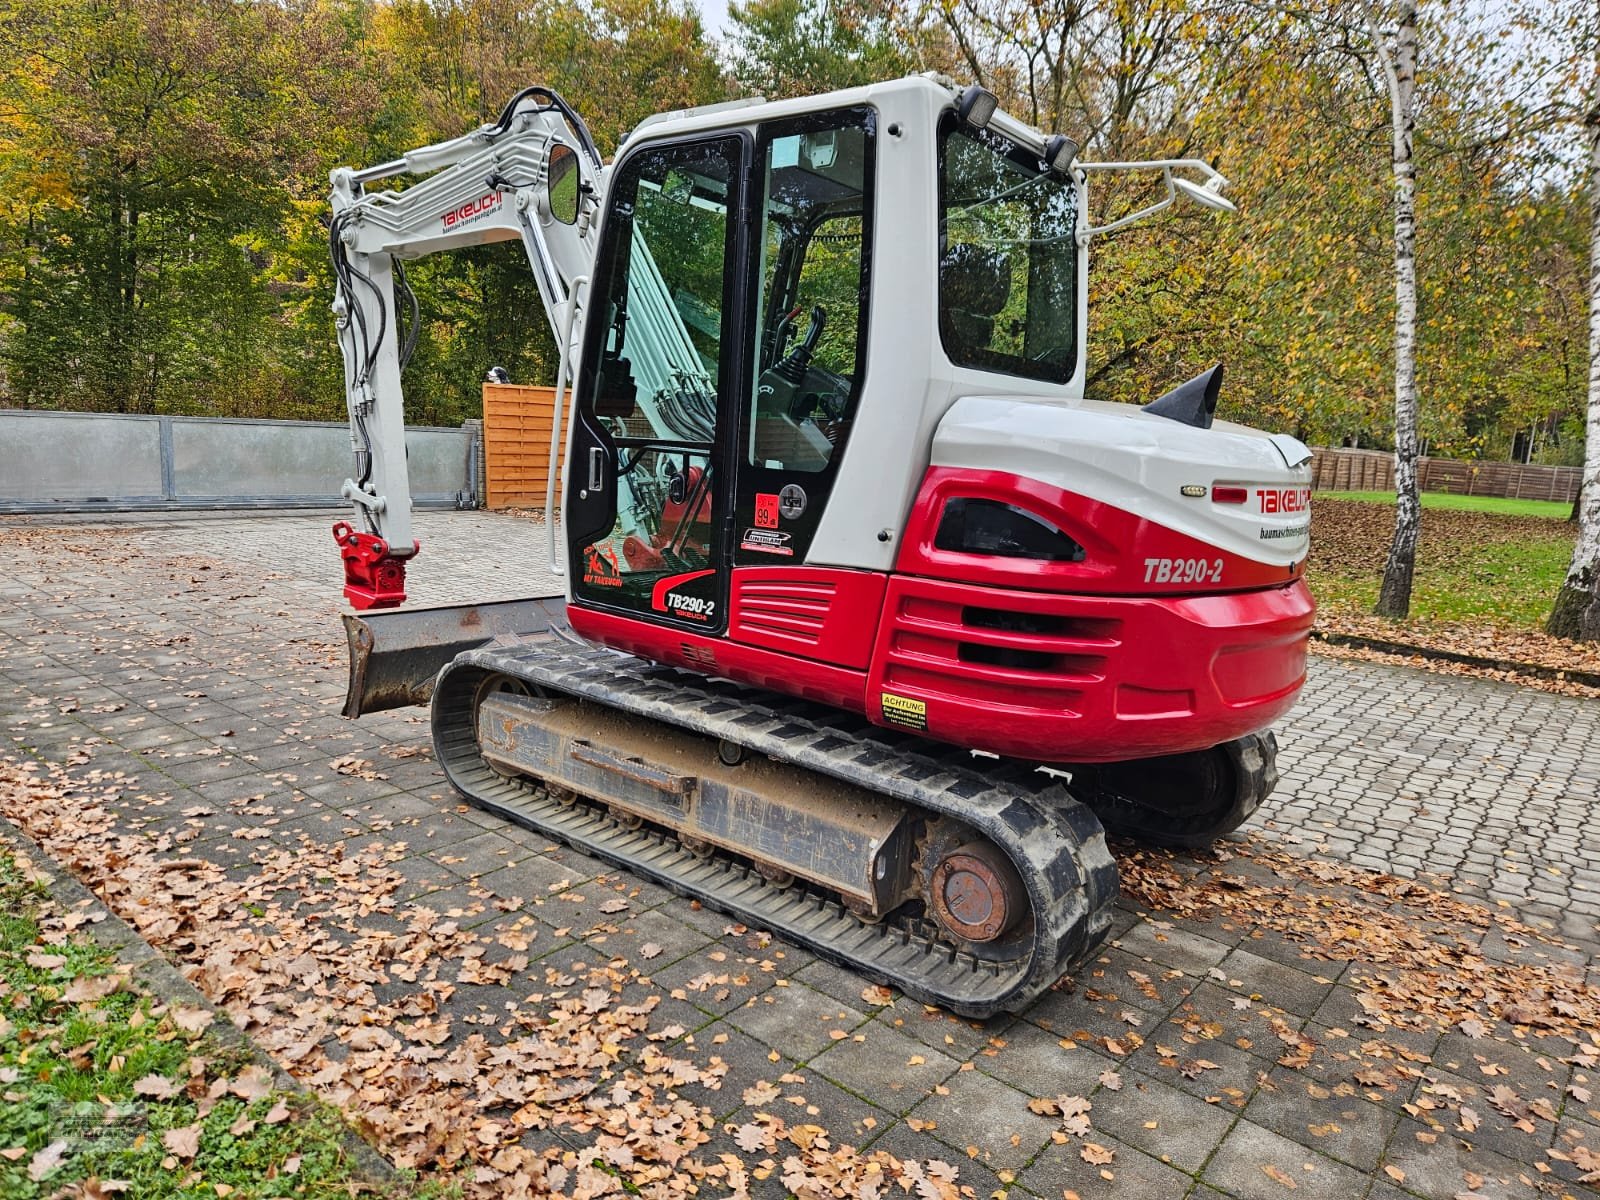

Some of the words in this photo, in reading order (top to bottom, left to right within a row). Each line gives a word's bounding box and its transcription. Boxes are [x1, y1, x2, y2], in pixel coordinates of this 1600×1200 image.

[440, 191, 502, 227] TAKEUCHI
[757, 509, 769, 524] 99
[1144, 558, 1224, 583] TB290-2
[668, 593, 715, 616] TB290-2
[674, 609, 708, 622] TAKEUCHI
[884, 696, 924, 712] ACHTUNG
